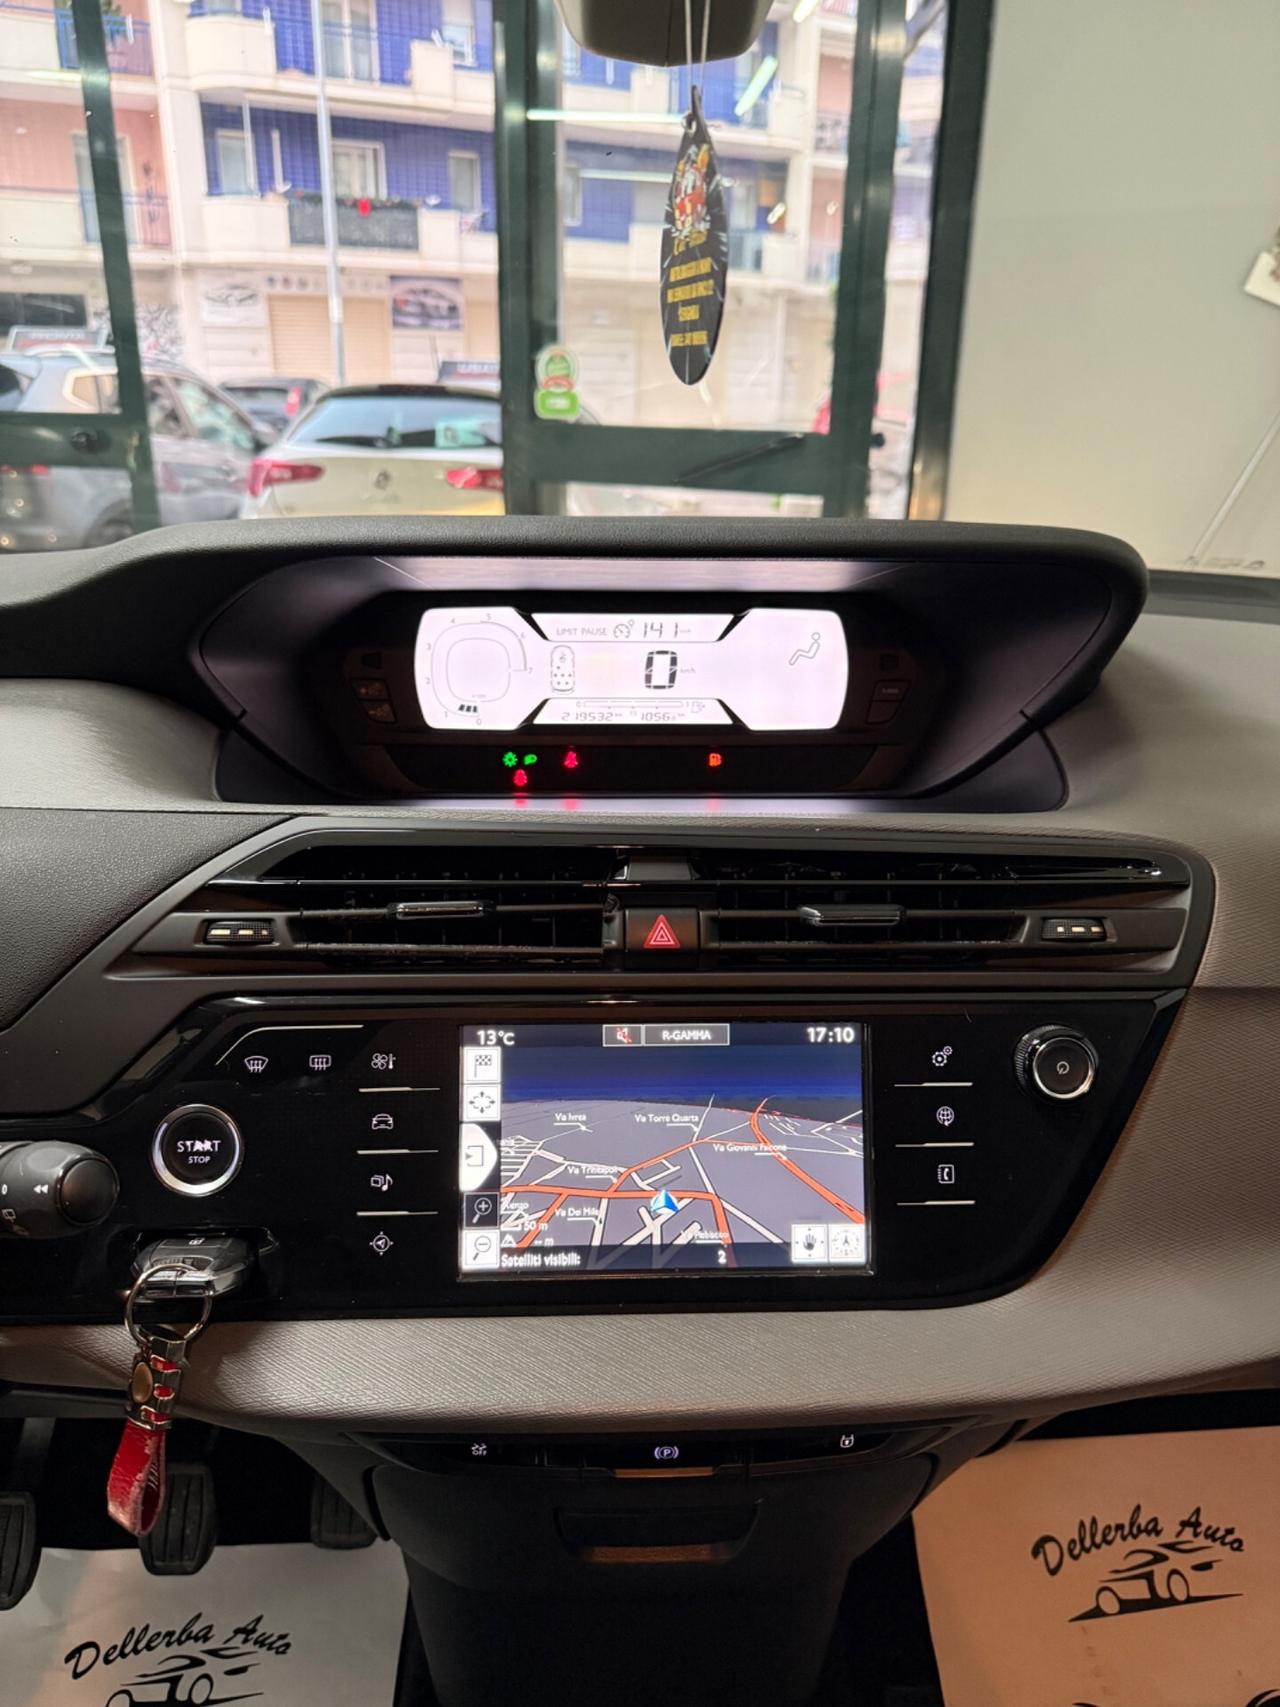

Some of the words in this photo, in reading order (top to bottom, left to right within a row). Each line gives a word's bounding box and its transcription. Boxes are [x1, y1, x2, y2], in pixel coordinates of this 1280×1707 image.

[556, 627, 578, 636] LIMIT
[581, 627, 608, 636] PAUSE
[643, 622, 679, 638] 141
[644, 650, 678, 690] 0
[477, 1029, 515, 1046] 13°C
[662, 1029, 712, 1041] R-GAMMA
[807, 1026, 855, 1043] 17:10
[648, 1113, 670, 1123] Torre
[176, 1139, 222, 1153] START
[188, 1155, 211, 1164] STOP
[501, 1254, 542, 1267] Satelliti
[717, 1250, 727, 1264] 2
[1030, 1503, 1164, 1577] Dellerba
[1175, 1506, 1245, 1552] Auto
[64, 1612, 214, 1680] Dellerba
[222, 1614, 292, 1655] Auto
